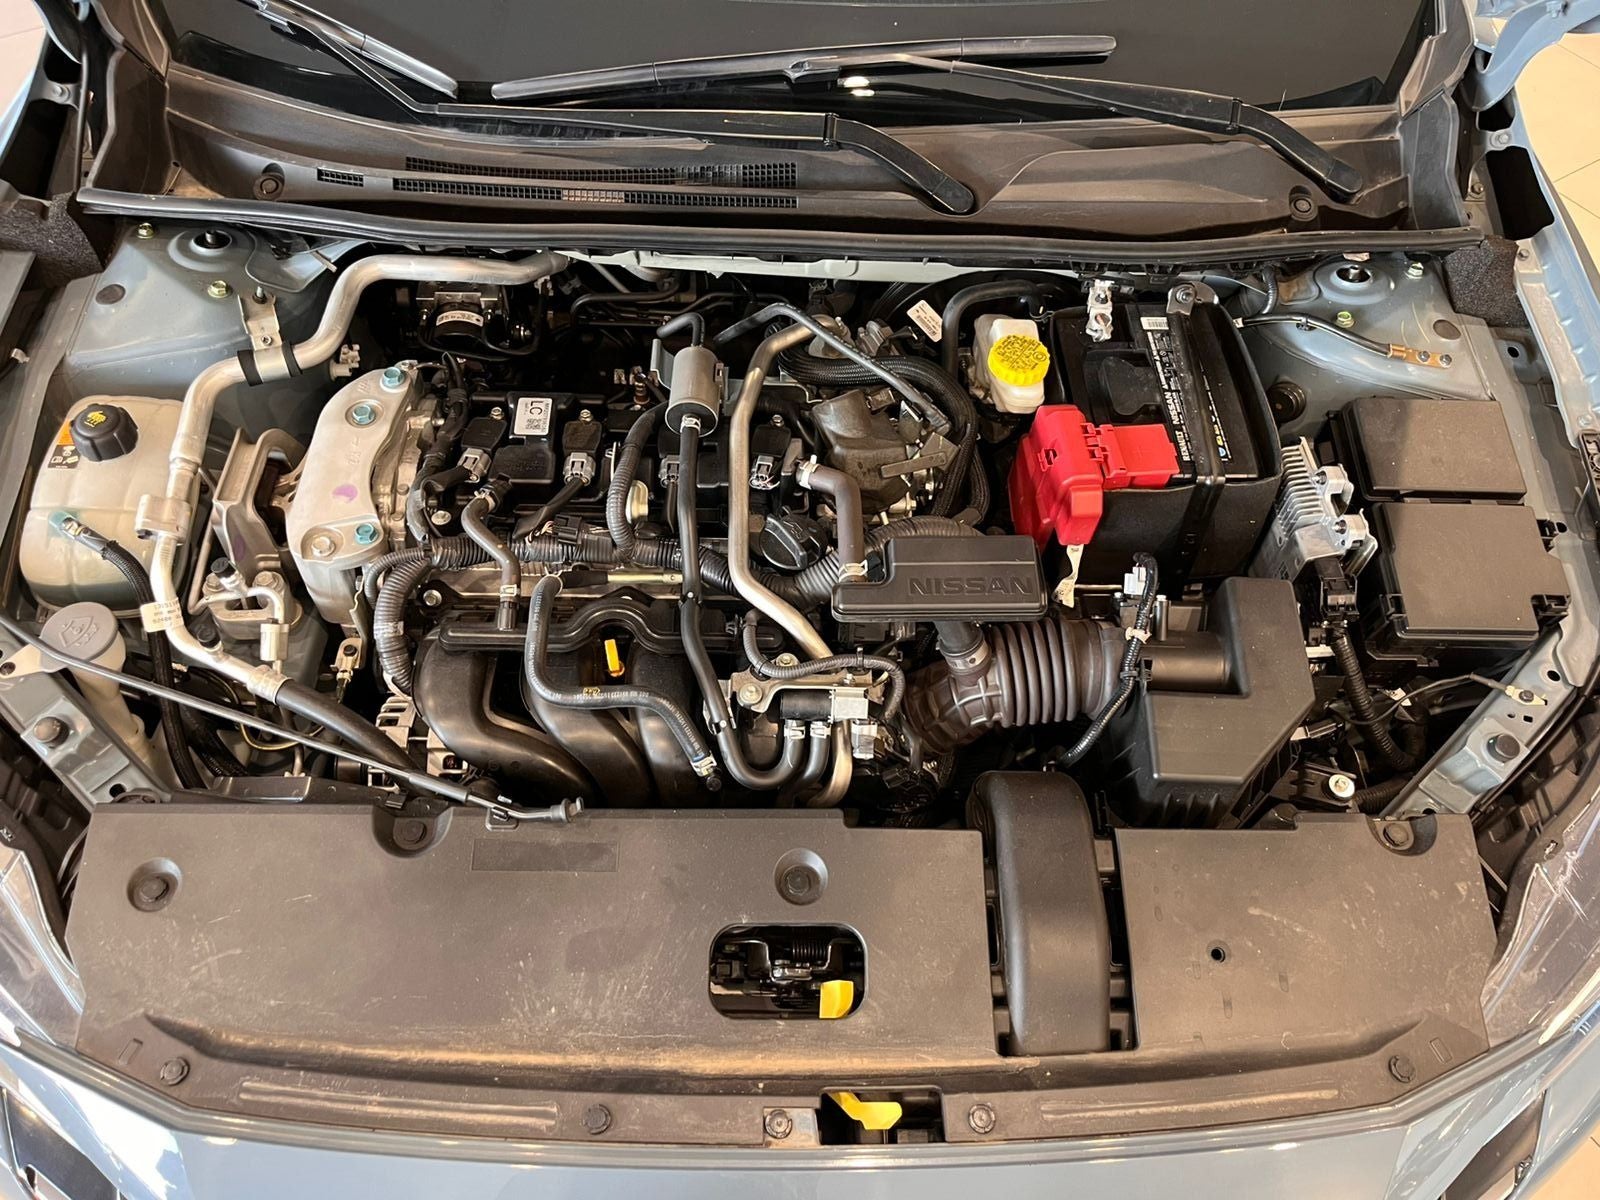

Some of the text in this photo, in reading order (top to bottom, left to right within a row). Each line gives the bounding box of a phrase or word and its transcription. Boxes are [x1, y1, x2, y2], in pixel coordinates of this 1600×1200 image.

[529, 400, 544, 415] LC
[1164, 391, 1180, 425] NISSAN
[1175, 430, 1191, 461] RENAULT
[908, 577, 1034, 596] NISSAN
